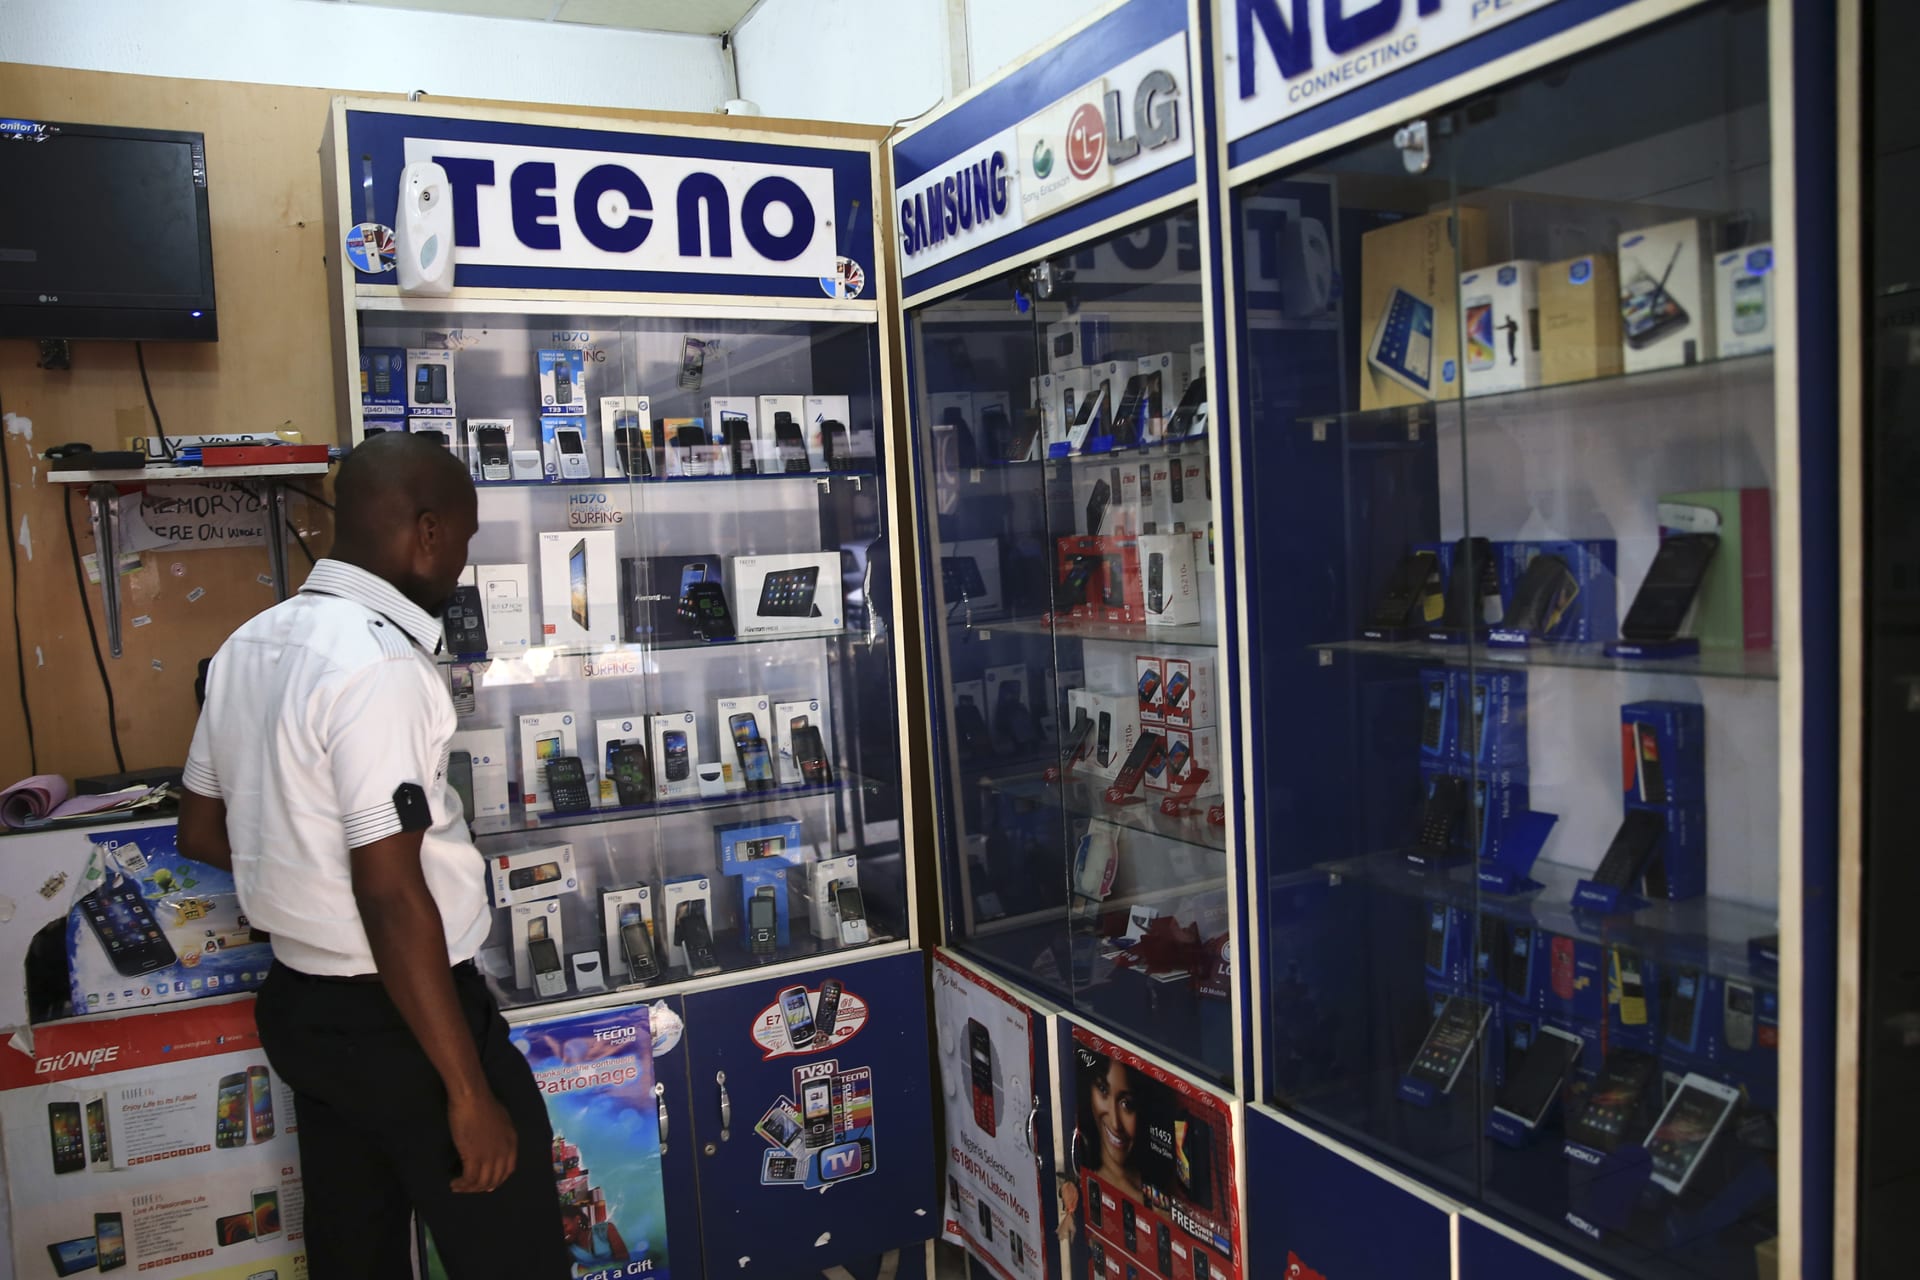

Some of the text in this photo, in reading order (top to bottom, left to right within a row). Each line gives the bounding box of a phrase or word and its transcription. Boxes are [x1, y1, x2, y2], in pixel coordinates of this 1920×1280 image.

[1288, 33, 1419, 103] CONNECTING
[1104, 70, 1180, 166] LG
[432, 157, 815, 262] TECNO
[901, 151, 1009, 256] SAMSUNG
[552, 332, 589, 342] HD70
[569, 493, 607, 505] HD70
[571, 512, 623, 524] SURFING
[200, 524, 224, 541] ON
[1489, 631, 1526, 643] NOKIA
[584, 663, 635, 677] SURFING
[766, 1014, 781, 1026] E7
[594, 1025, 636, 1043] TECNO
[610, 1036, 637, 1046] Mobile
[536, 1066, 637, 1094] Patronage
[798, 1062, 834, 1080] TV30
[841, 1071, 869, 1083] TECNO
[780, 1100, 799, 1118] TV60
[827, 1149, 855, 1172] TV
[1564, 1144, 1601, 1165] NOKIA
[281, 1166, 294, 1176] G3
[983, 1149, 1016, 1188] Selection
[974, 1163, 986, 1185] FM
[986, 1174, 1010, 1203] Listen
[1009, 1193, 1030, 1224] More
[1171, 1207, 1196, 1235] FREE
[1565, 1211, 1601, 1240] NOKIA
[613, 1269, 622, 1279] a
[627, 1259, 653, 1275] Gift
